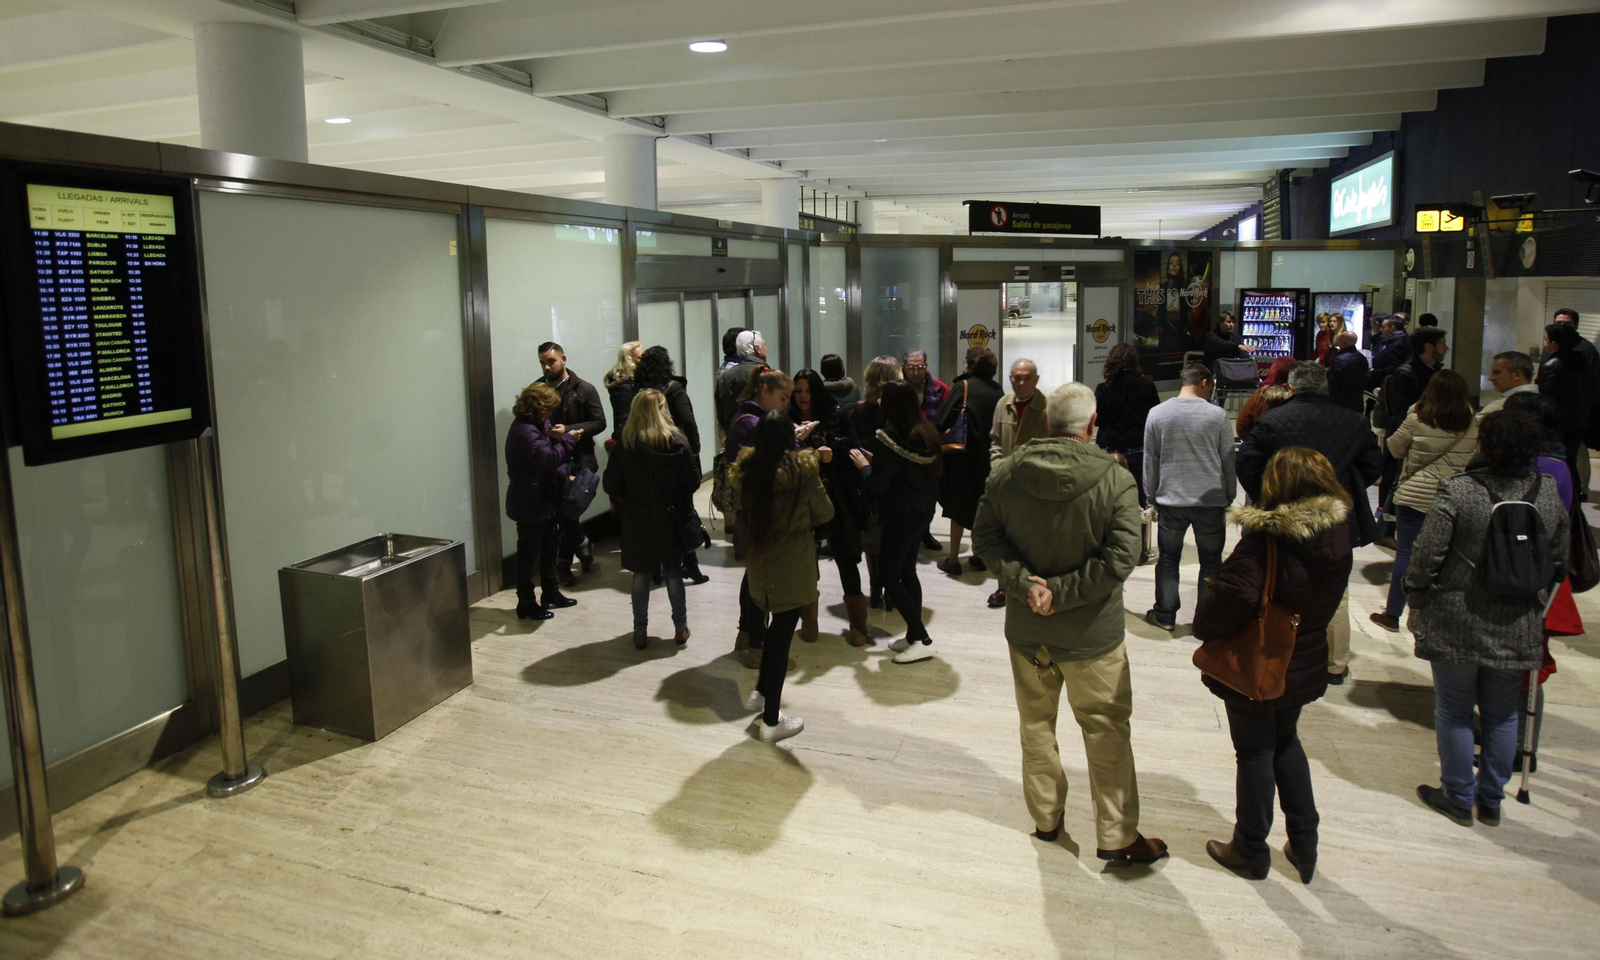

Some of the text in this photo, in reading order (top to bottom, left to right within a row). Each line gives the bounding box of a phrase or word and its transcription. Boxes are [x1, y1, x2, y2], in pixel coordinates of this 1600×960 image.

[58, 192, 103, 202] LLEGADAS
[110, 196, 148, 205] ARRIVALS
[1012, 220, 1071, 230] Salida de pasajeros
[1137, 288, 1165, 305] THIS
[1180, 288, 1193, 297] Hard
[1195, 287, 1208, 298] Rock
[1085, 323, 1116, 334] Hard Rock
[960, 329, 996, 340] Hard Rock
